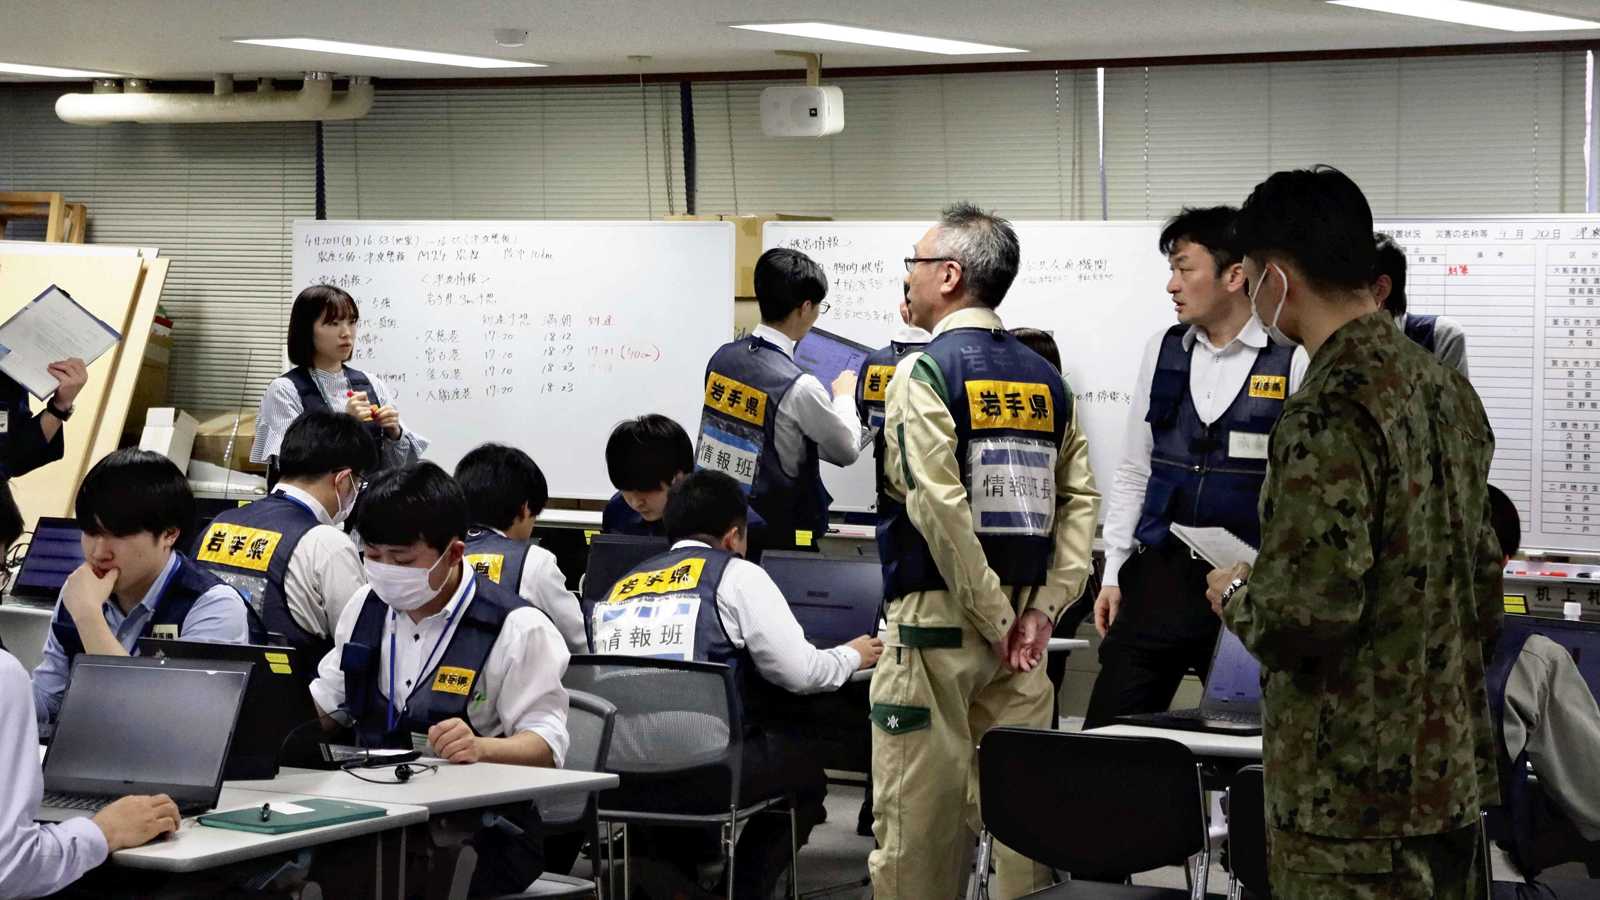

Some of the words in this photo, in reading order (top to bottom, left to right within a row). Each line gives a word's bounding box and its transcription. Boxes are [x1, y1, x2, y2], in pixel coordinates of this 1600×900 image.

[711, 382, 759, 417] 岩手県
[980, 390, 1048, 419] 岩手県
[700, 441, 752, 478] 情報班
[983, 474, 1051, 499] 情報班長
[207, 531, 268, 560] 岩手県
[619, 564, 691, 594] 岩手県
[603, 623, 683, 653] 情報班
